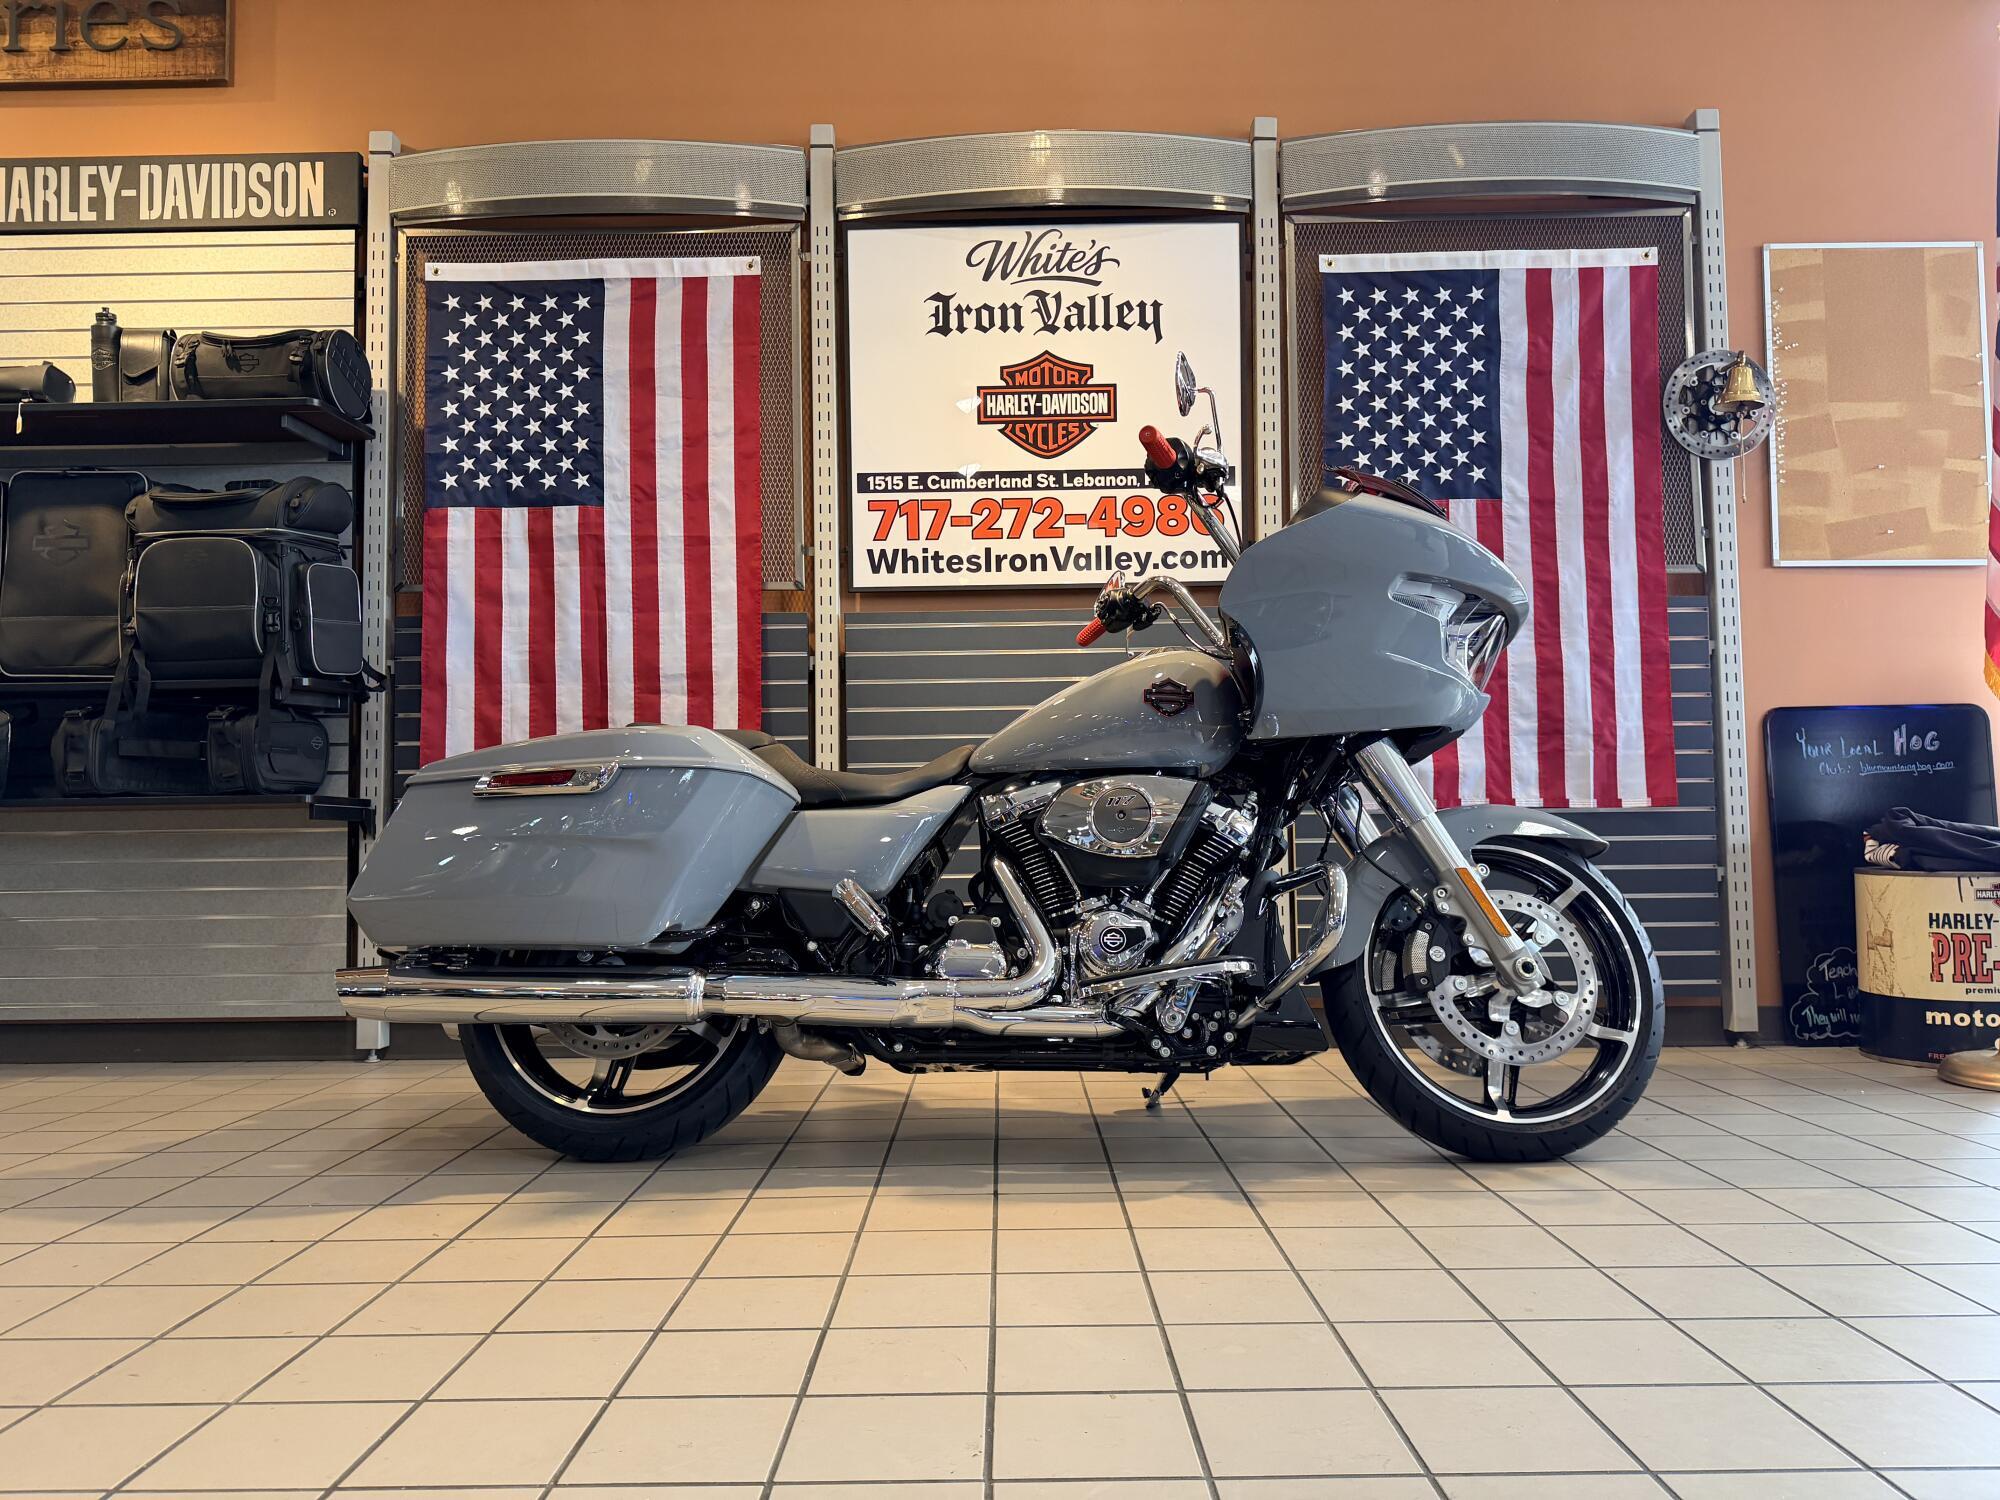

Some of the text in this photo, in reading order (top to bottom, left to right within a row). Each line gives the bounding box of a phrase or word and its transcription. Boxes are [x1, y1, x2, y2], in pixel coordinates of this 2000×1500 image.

[0, 0, 183, 52] ries
[966, 229, 1120, 283] White's
[923, 289, 1164, 344] Iron Valley
[1015, 361, 1079, 386] MOTOR
[986, 392, 1108, 416] HARLEY-DAVIDSON
[1016, 423, 1079, 450] CYCLES
[866, 475, 904, 491] 1515
[907, 475, 924, 490] E.
[927, 473, 1033, 490] Cumberland
[1036, 473, 1059, 488] St.
[1062, 472, 1141, 488] Lebanon,
[866, 545, 1228, 577] WhitesIronValley.com
[1106, 795, 1137, 807] 117
[1928, 1052, 1946, 1060] FRE
